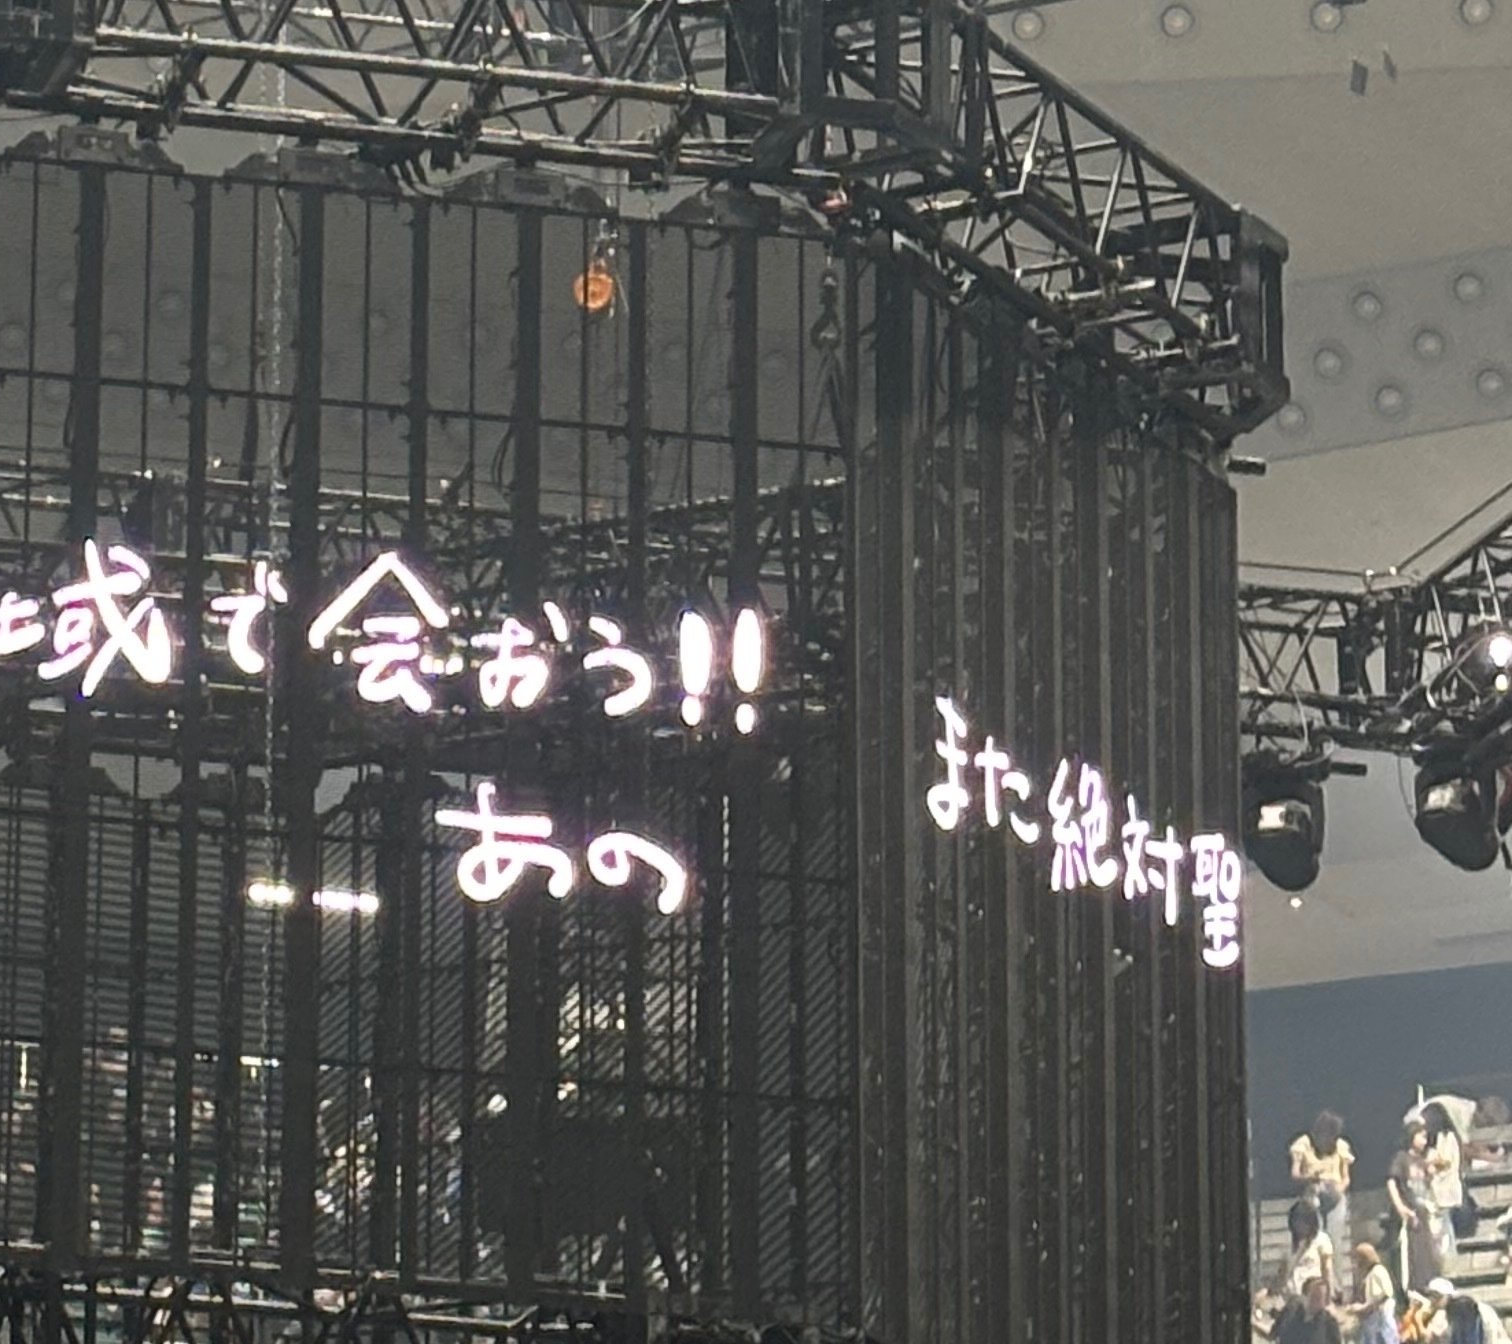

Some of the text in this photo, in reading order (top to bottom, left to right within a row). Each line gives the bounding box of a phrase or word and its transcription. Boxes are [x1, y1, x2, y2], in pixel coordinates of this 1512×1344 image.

[434, 782, 688, 915] あの
[926, 696, 1242, 967] また絶対聖
